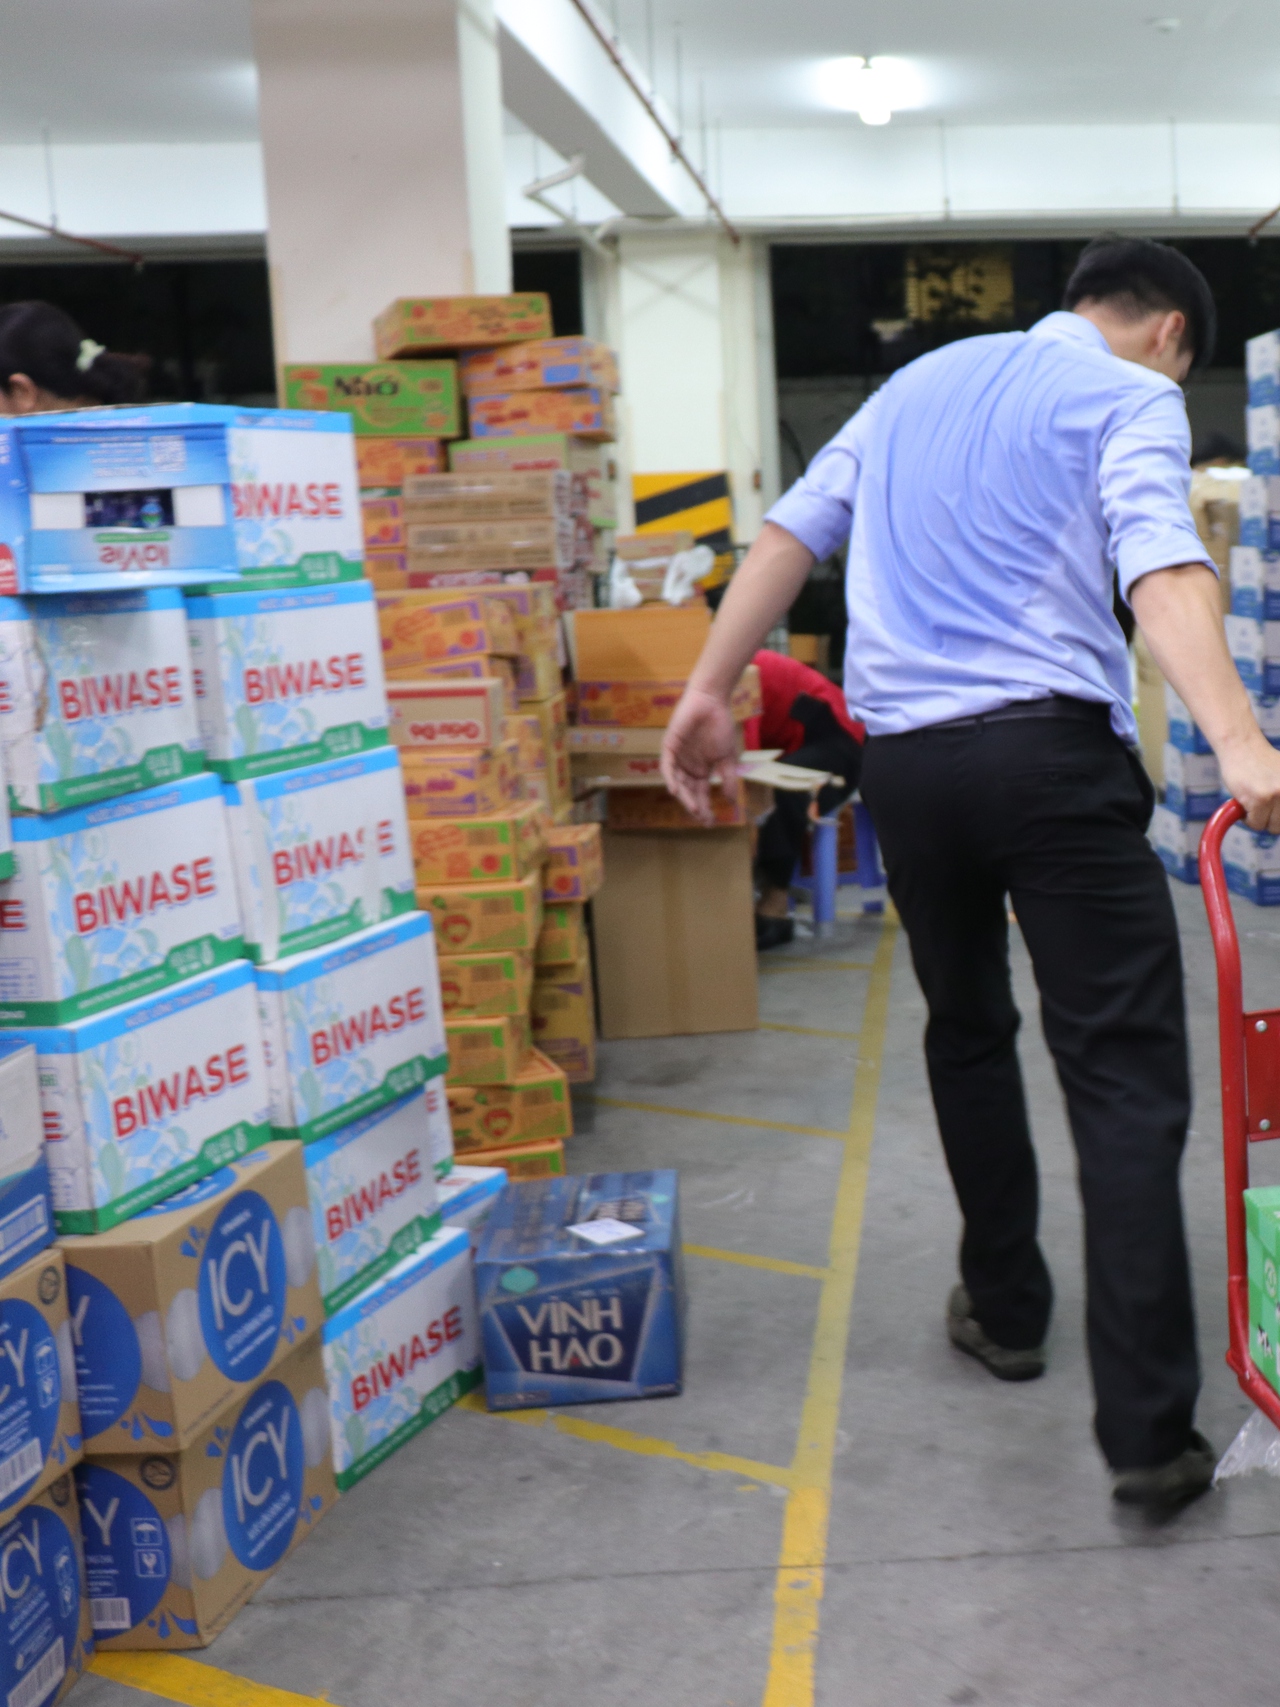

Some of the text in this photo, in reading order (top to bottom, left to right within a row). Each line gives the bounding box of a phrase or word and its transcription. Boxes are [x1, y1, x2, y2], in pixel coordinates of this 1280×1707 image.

[58, 667, 182, 720] BIWASE
[244, 653, 365, 704] BIWASE
[74, 856, 215, 935] BIWASE
[311, 987, 426, 1065] BIWASE
[112, 1043, 250, 1138] BIWASE
[326, 1148, 421, 1241] BIWASE
[208, 1219, 271, 1332] ICY
[351, 1305, 463, 1411] BIWASE
[232, 1405, 291, 1523] ICY
